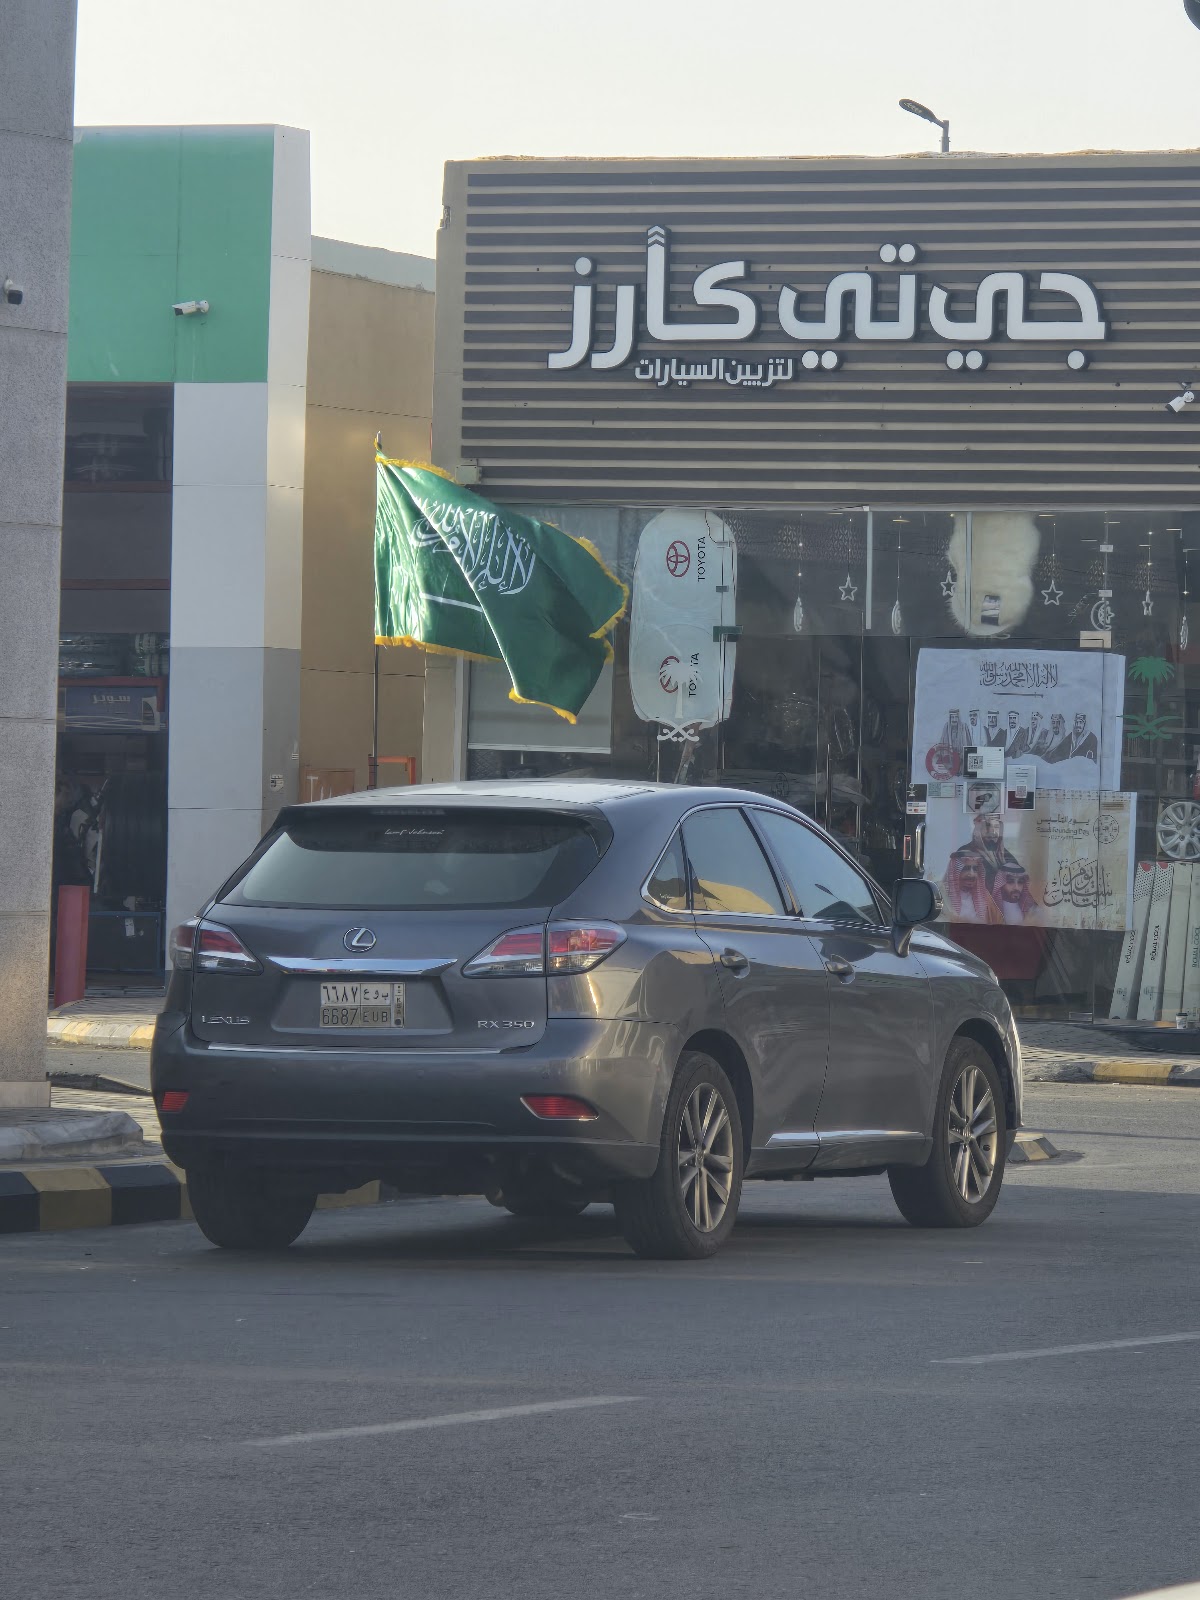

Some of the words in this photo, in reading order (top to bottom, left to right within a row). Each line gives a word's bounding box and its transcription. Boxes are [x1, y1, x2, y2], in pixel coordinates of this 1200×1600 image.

[778, 243, 916, 370] تي
[928, 272, 1106, 369] جي
[634, 358, 724, 386] السيارات
[725, 358, 793, 387] لتزيين
[697, 536, 706, 583] TOYOTA
[322, 1007, 359, 1026] 6687
[363, 1010, 388, 1023] EUB
[477, 1020, 500, 1029] RX
[502, 1020, 535, 1029] 350
